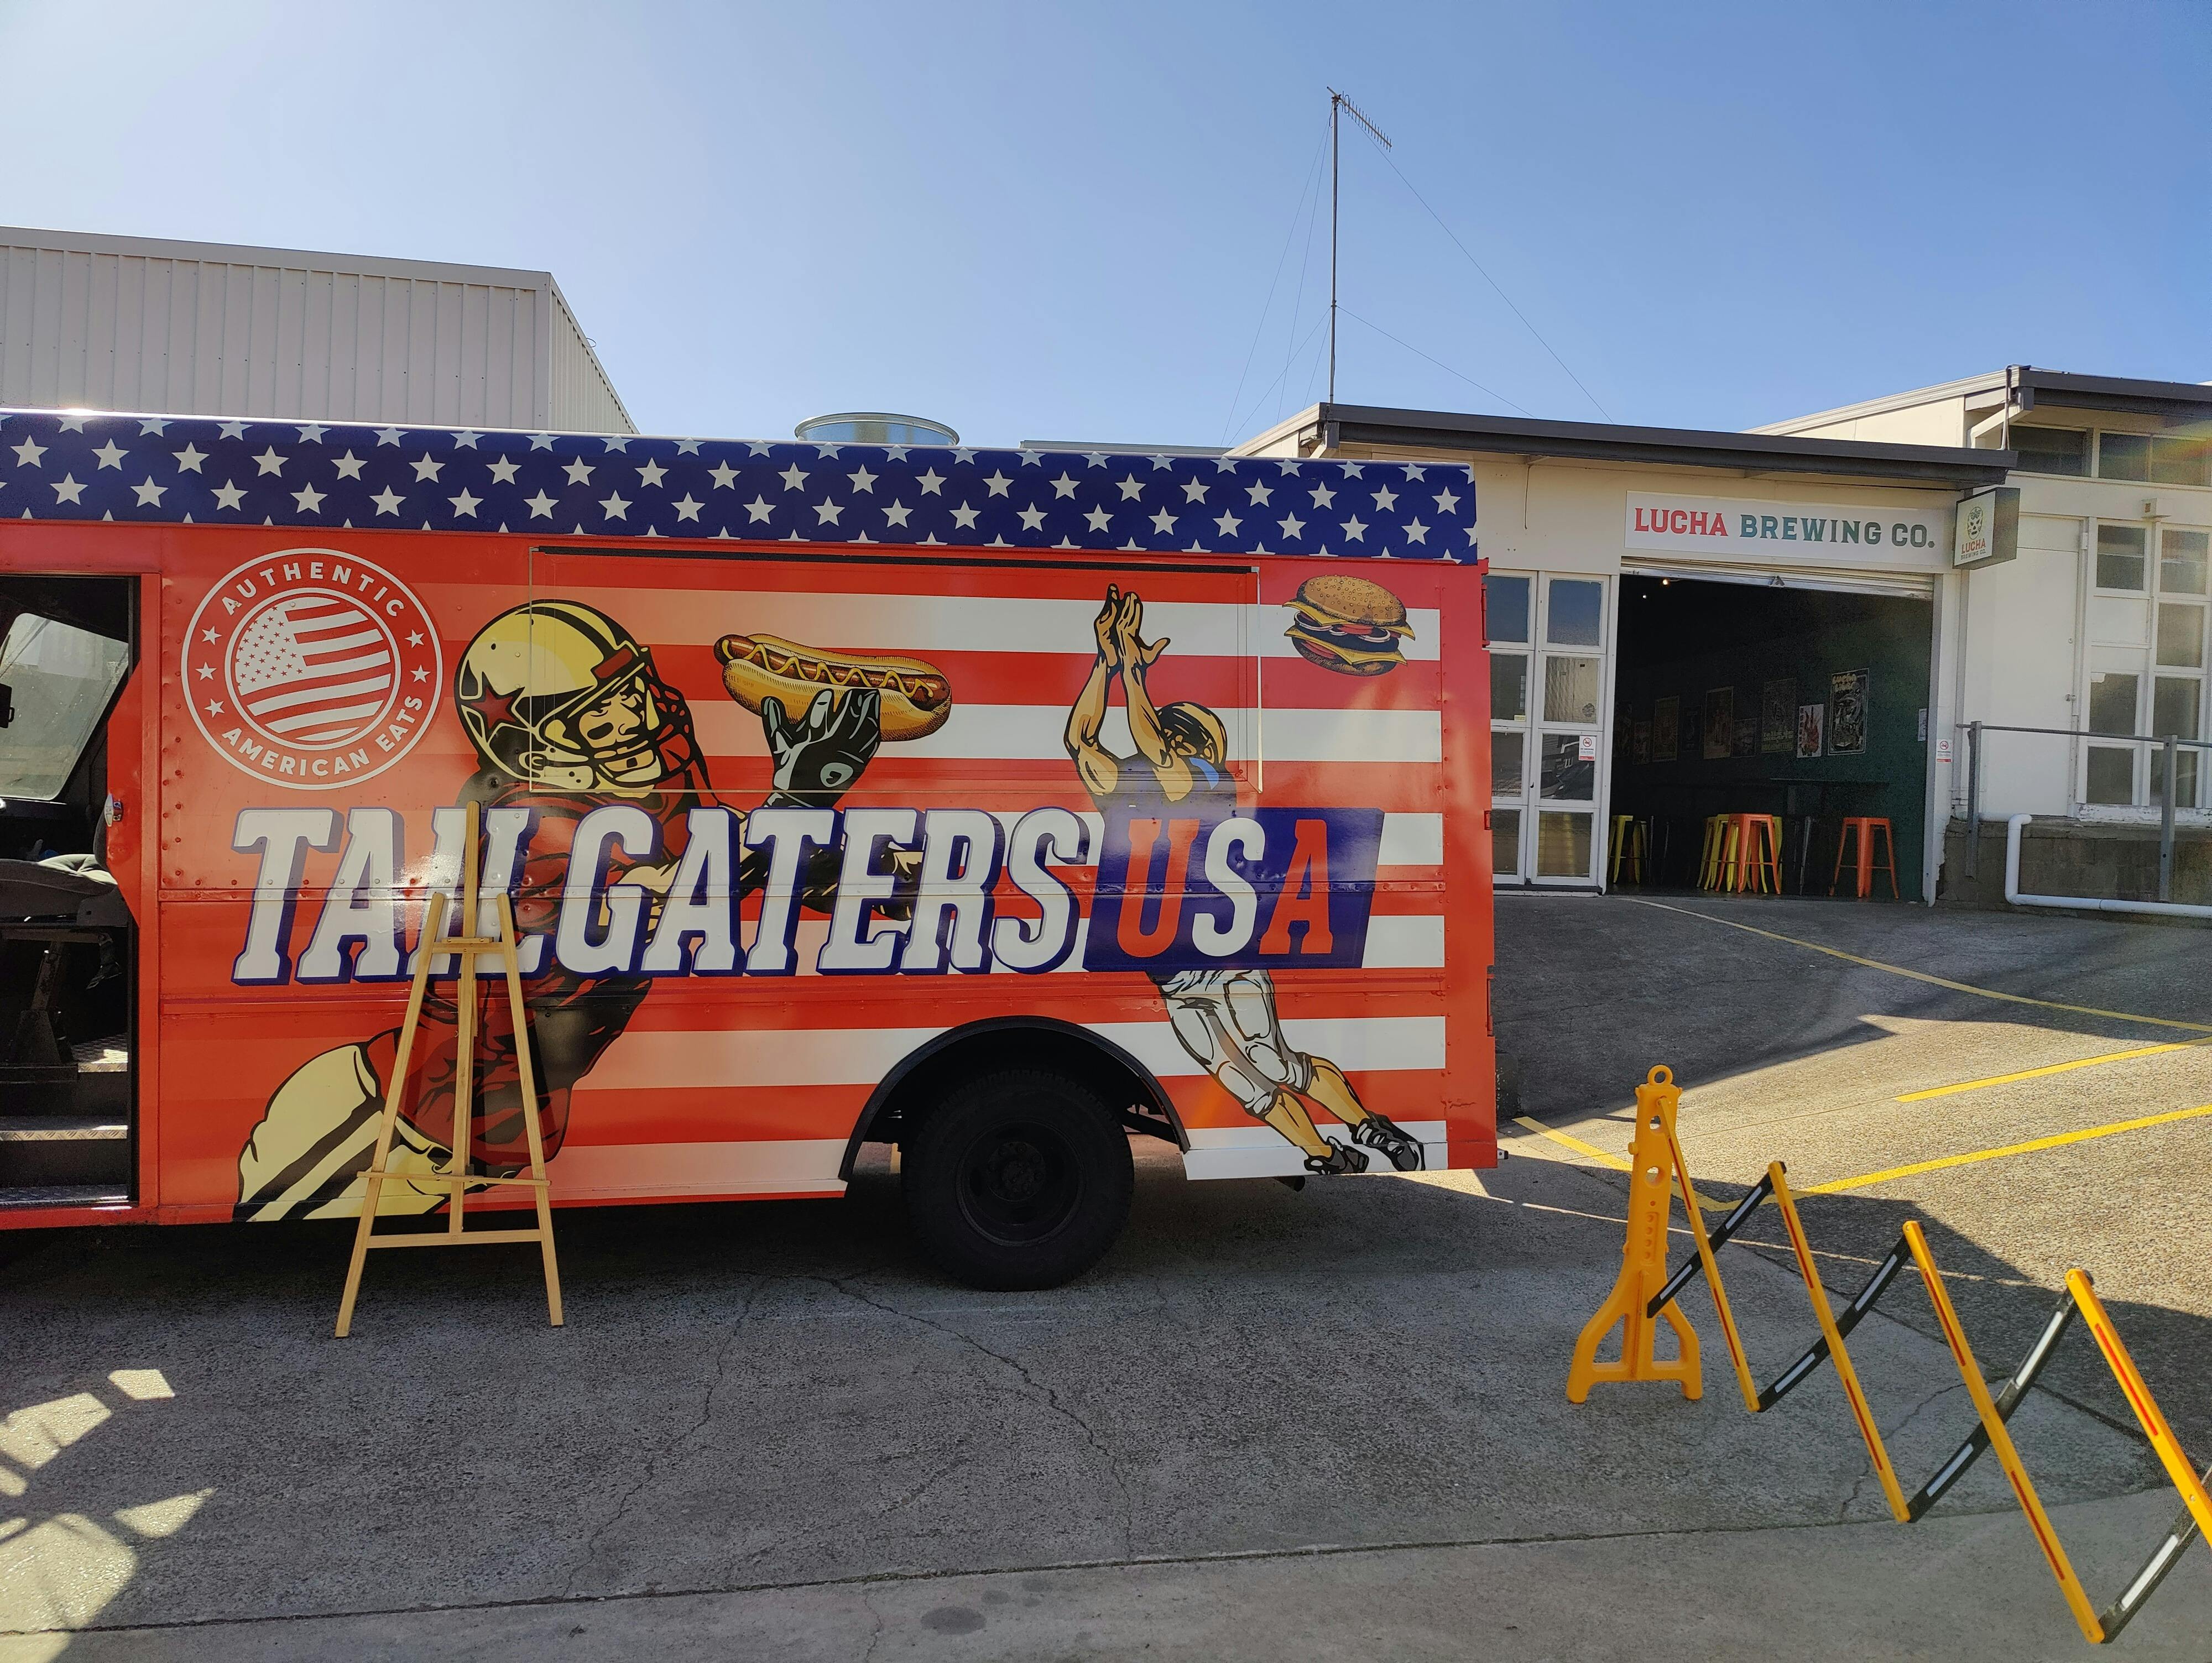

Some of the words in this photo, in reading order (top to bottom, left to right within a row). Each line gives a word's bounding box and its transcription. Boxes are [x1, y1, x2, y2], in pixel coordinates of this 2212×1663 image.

[1634, 507, 1728, 537] LUCHA
[1740, 514, 1882, 545] BREWING
[1891, 523, 1936, 548] CO.
[1961, 538, 1986, 554] LUCHA
[221, 562, 405, 617] AUTHENTIC
[222, 728, 370, 776] AMERICAN
[375, 695, 422, 752] EATS
[231, 806, 1091, 985] TAILGATERS
[1116, 817, 1334, 959] USA
